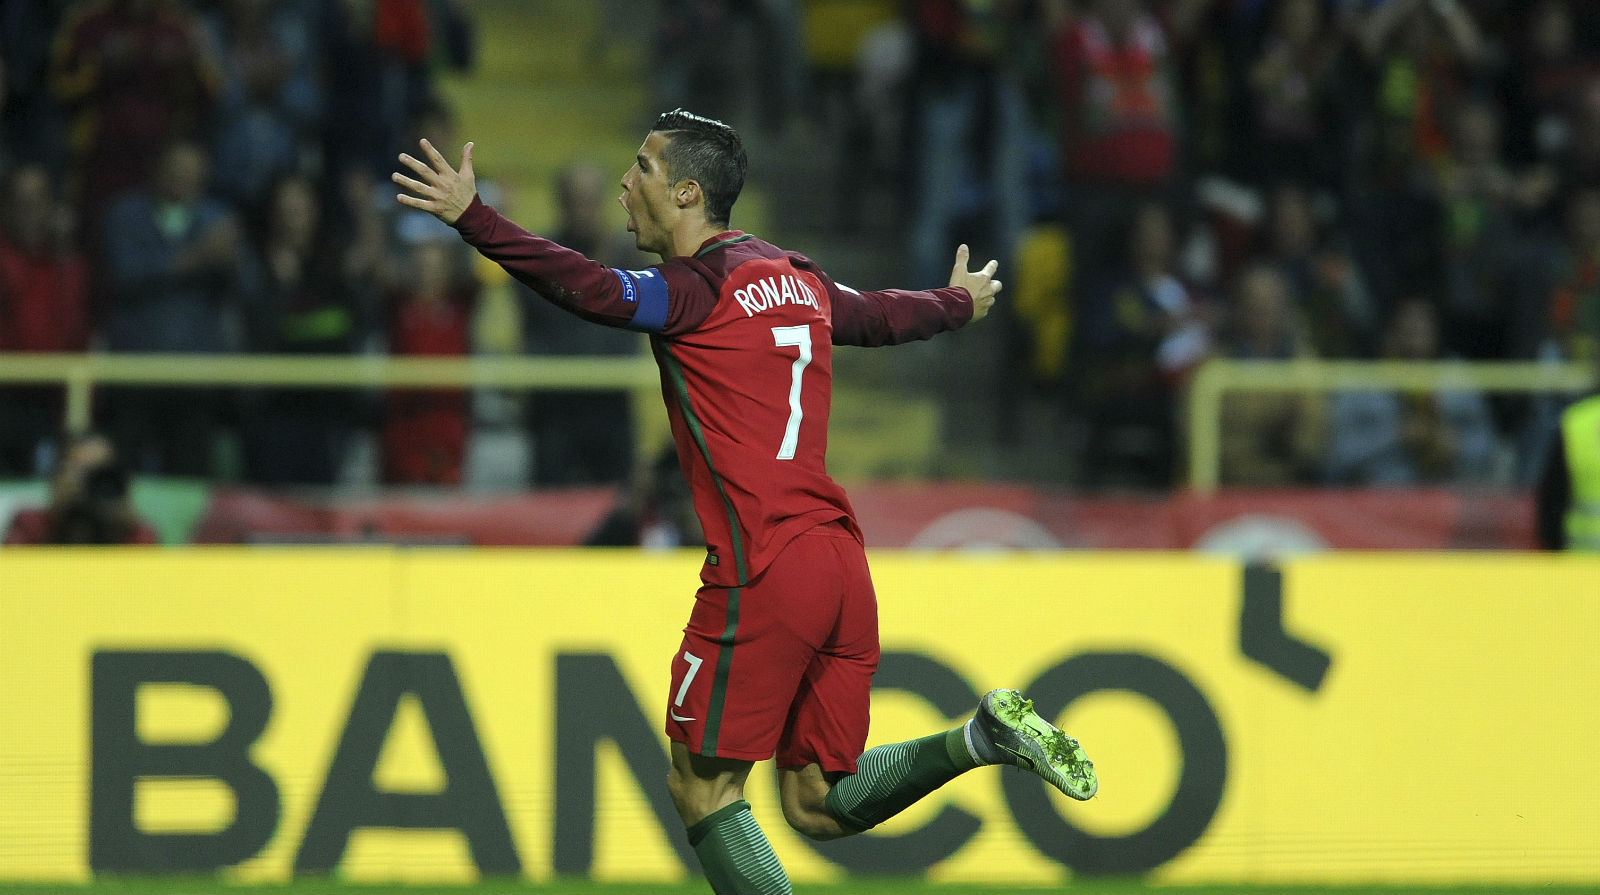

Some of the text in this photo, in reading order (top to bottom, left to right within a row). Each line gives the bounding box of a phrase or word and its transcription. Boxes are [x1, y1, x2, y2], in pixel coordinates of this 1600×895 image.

[614, 269, 634, 302] ESPECT
[733, 275, 820, 318] RONALDO
[771, 324, 813, 460] 7
[674, 650, 704, 707] 7
[91, 648, 1228, 876] BANCO
